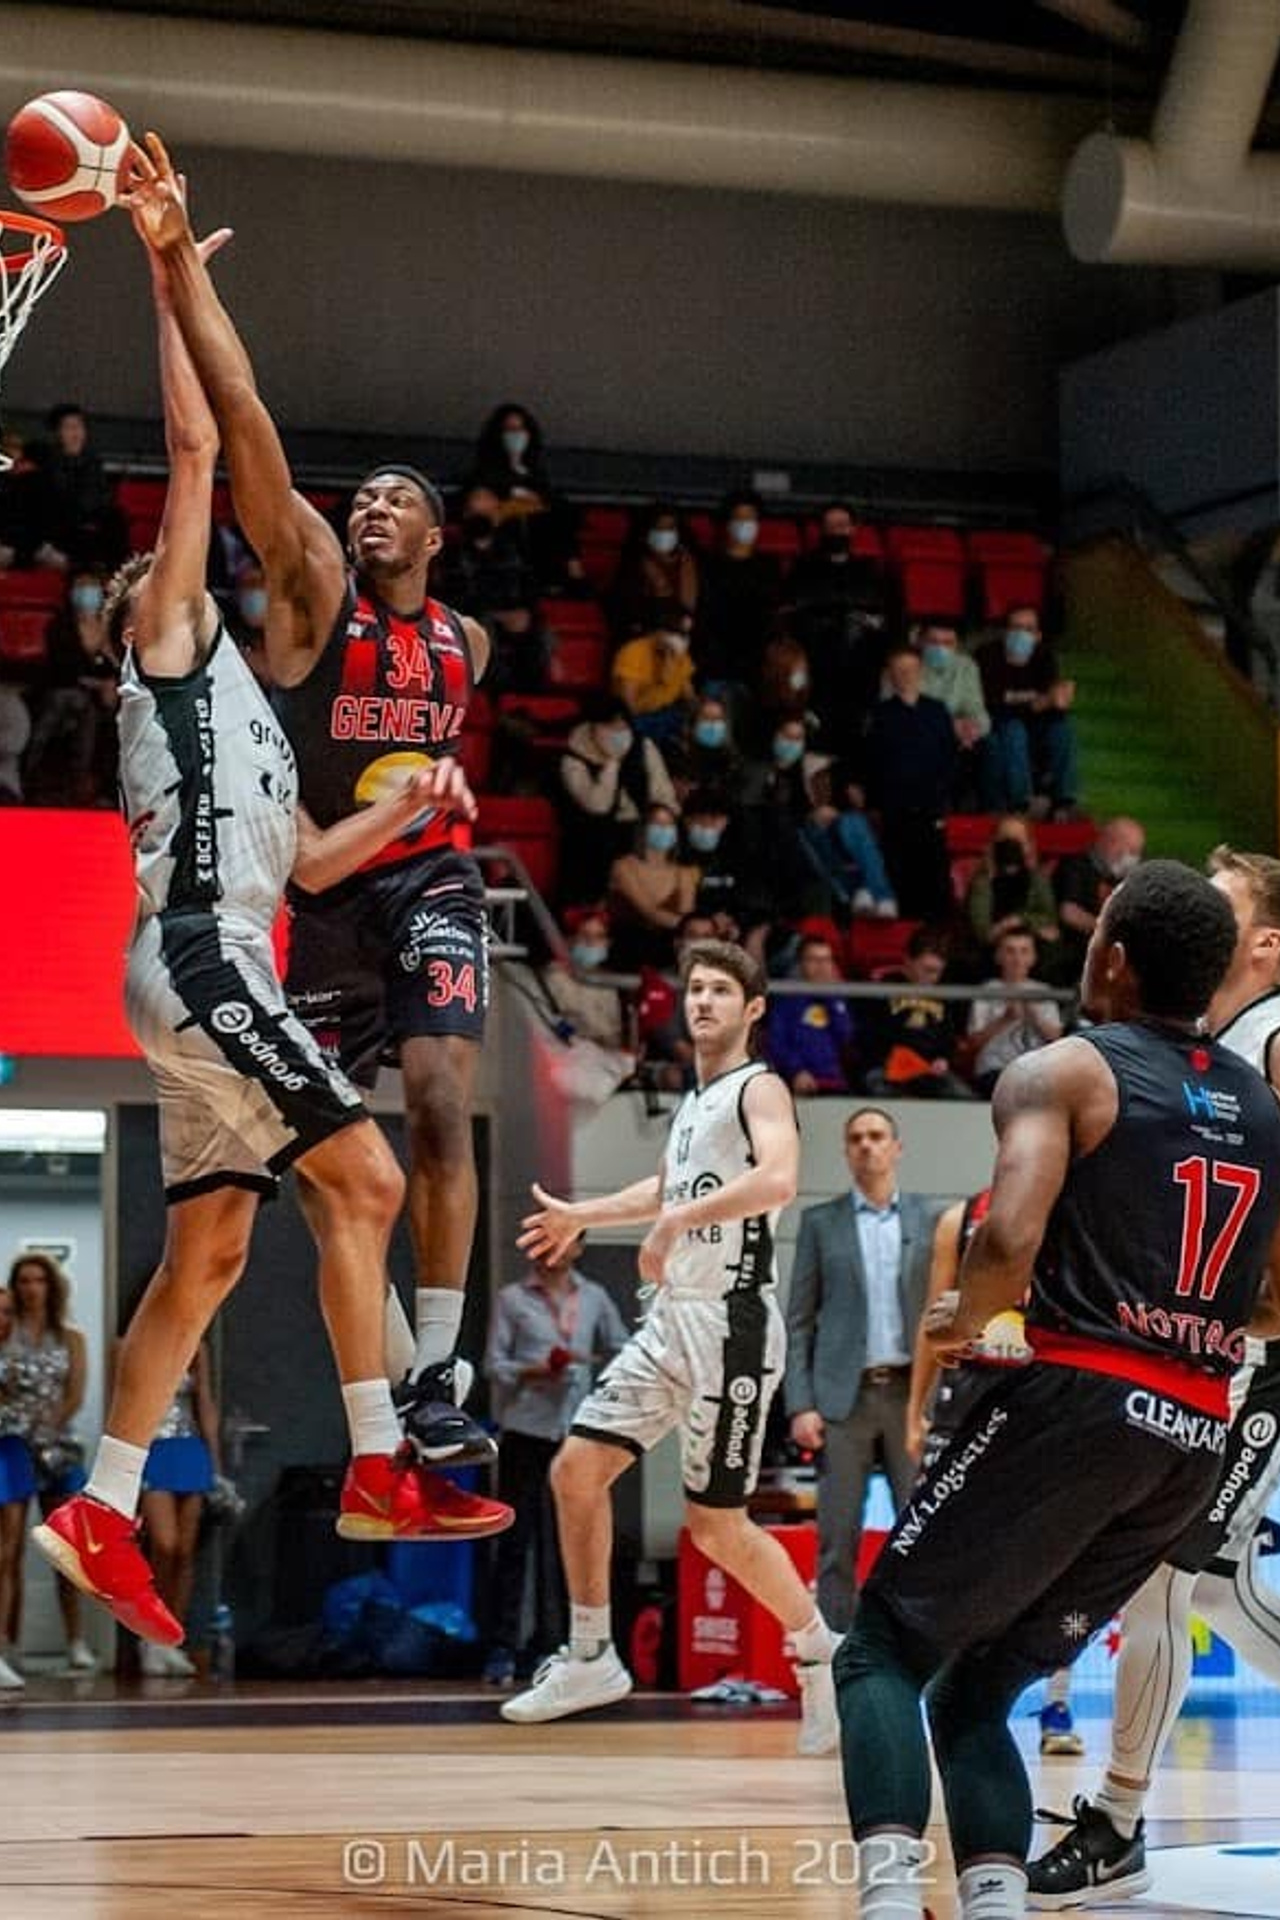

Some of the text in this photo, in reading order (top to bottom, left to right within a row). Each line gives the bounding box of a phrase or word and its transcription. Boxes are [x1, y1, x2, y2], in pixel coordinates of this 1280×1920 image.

[386, 634, 434, 692] 34
[427, 960, 477, 1013] 34
[239, 1031, 309, 1091] groupe
[1173, 1155, 1260, 1300] 17
[725, 1406, 750, 1469] groupe
[1208, 1448, 1256, 1523] groupe
